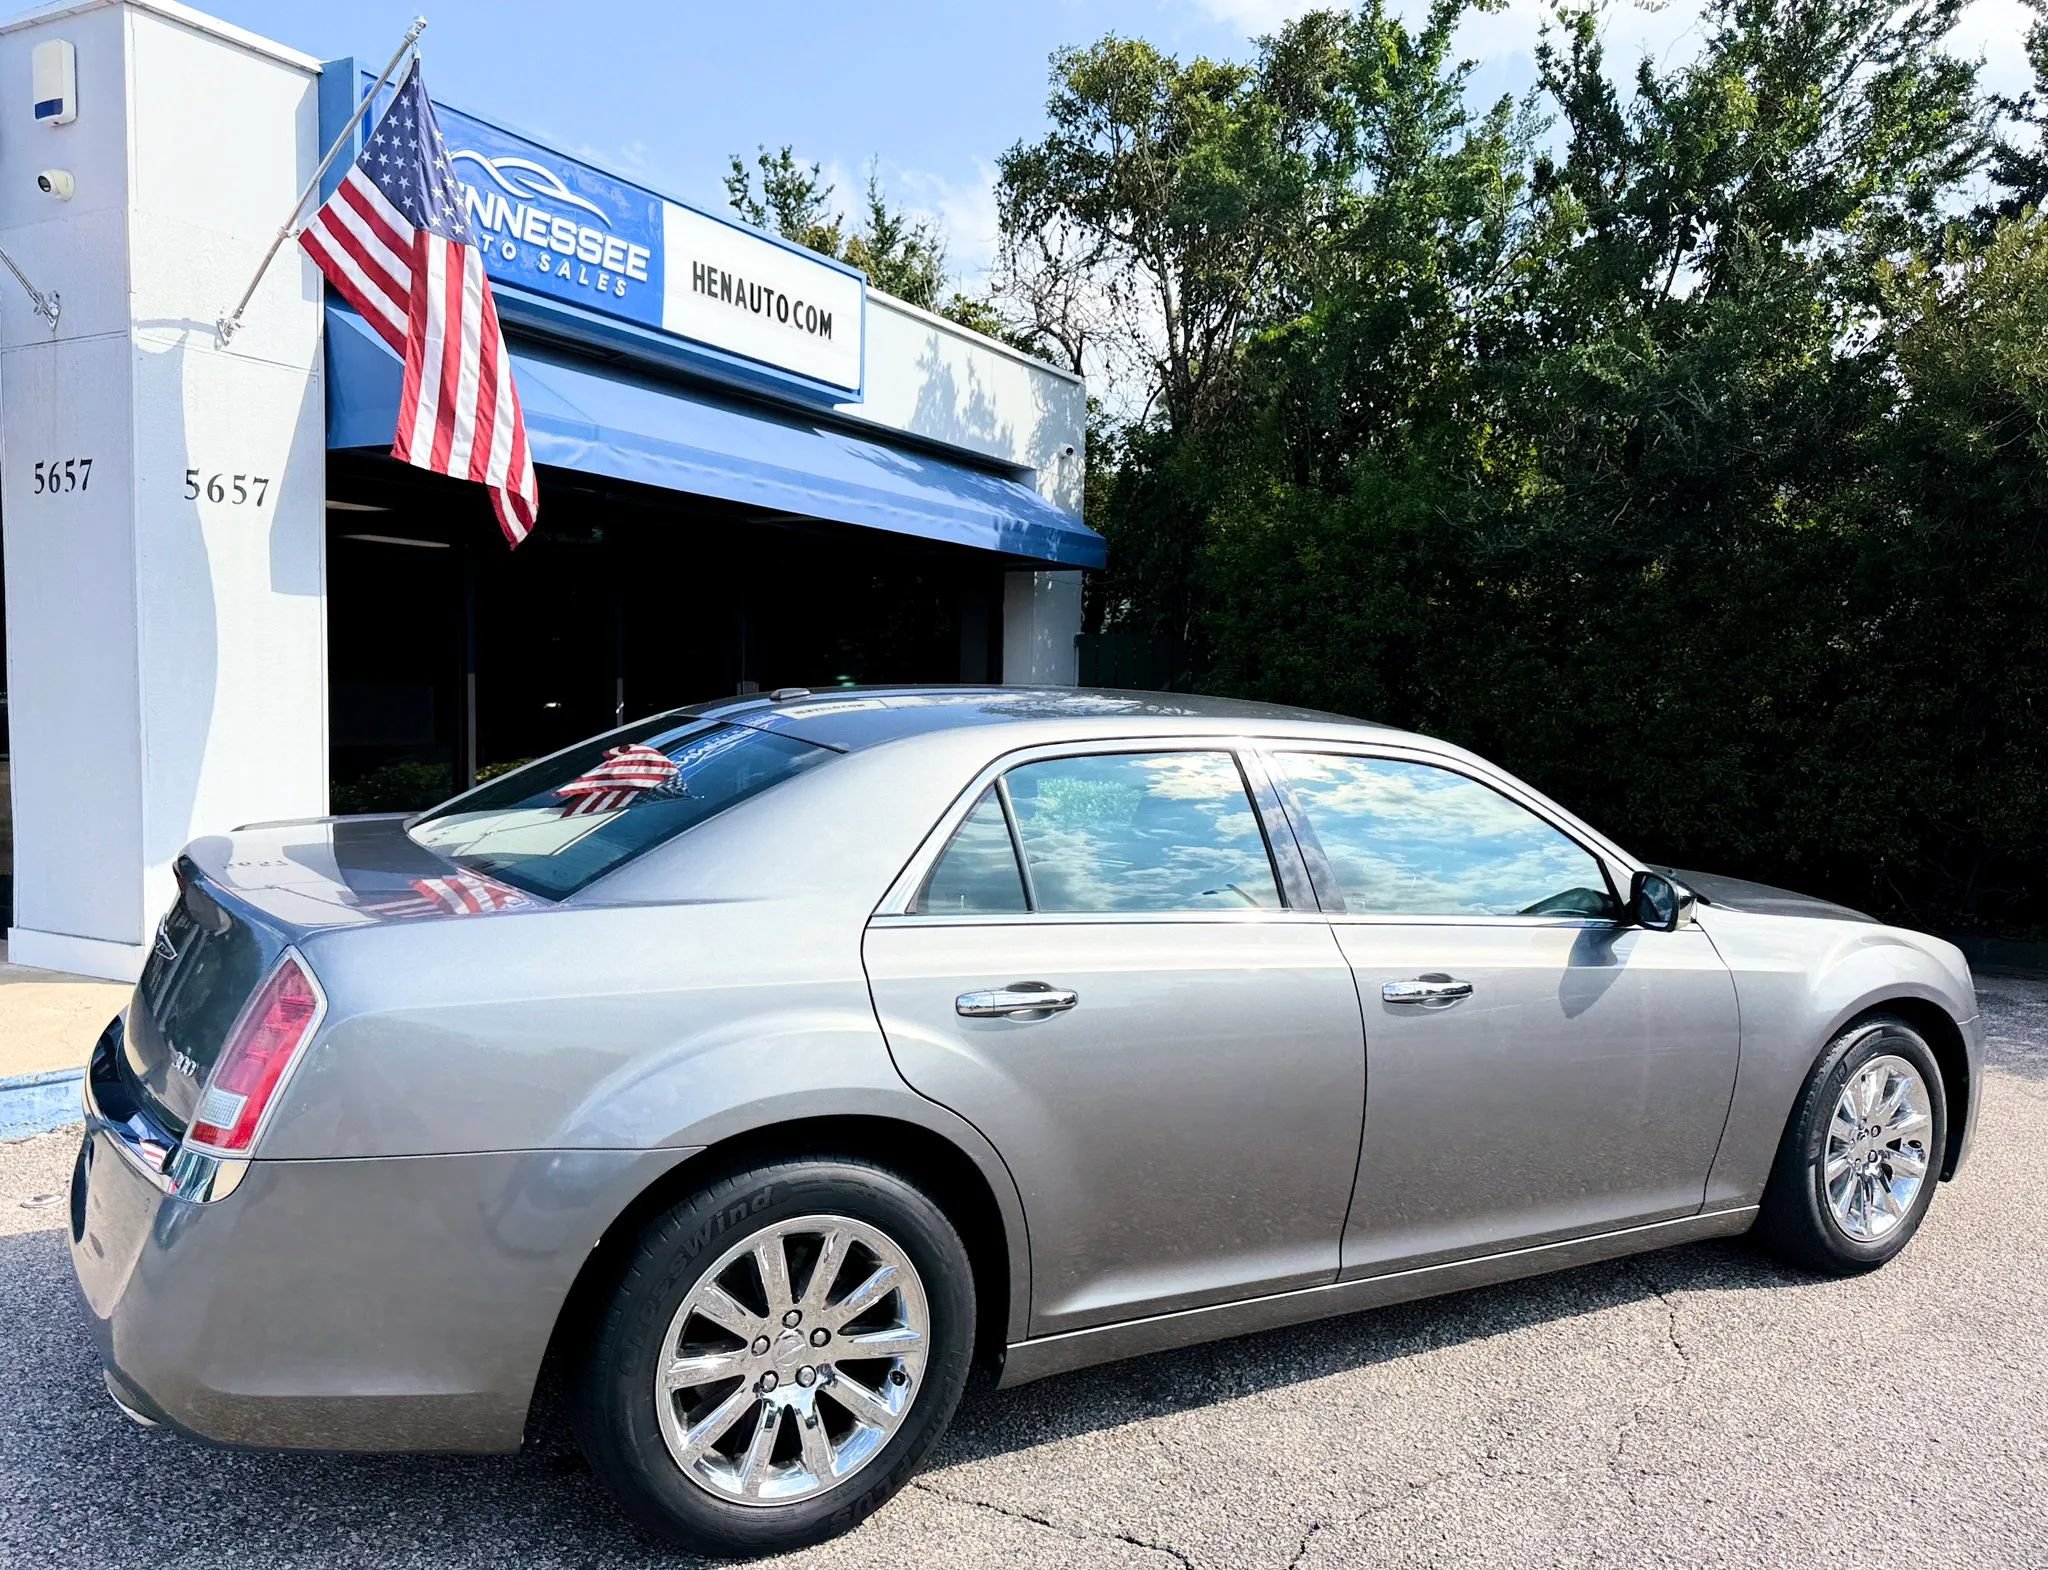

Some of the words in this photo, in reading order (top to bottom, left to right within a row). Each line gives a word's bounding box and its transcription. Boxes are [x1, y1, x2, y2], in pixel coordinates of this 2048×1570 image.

[459, 181, 651, 283] NNESSEE
[478, 232, 518, 261] TO
[537, 251, 628, 298] SALES
[33, 457, 93, 496] 5657
[183, 468, 271, 508] 5657
